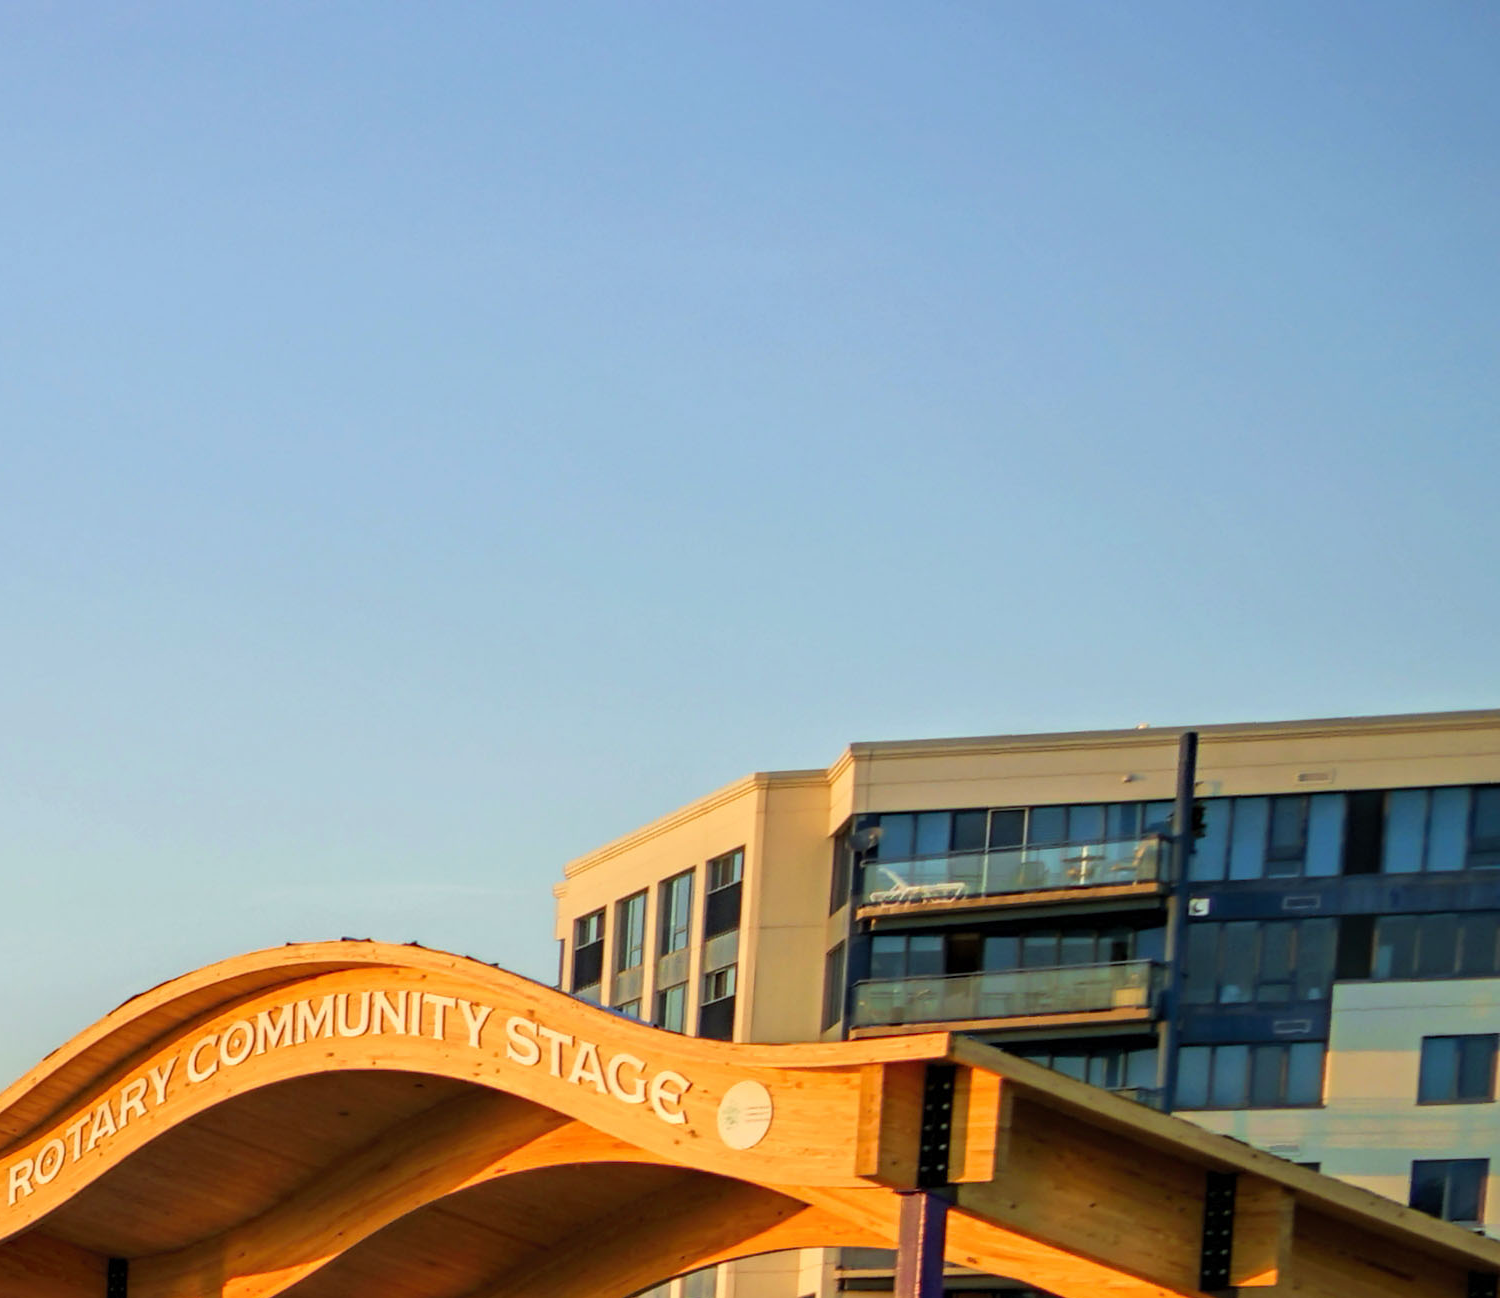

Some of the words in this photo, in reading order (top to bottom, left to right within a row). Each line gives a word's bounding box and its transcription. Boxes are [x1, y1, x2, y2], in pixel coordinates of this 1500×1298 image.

[7, 1056, 179, 1206] ROTARY
[186, 990, 494, 1084] COMMUNITY
[505, 1016, 693, 1124] STAGE
